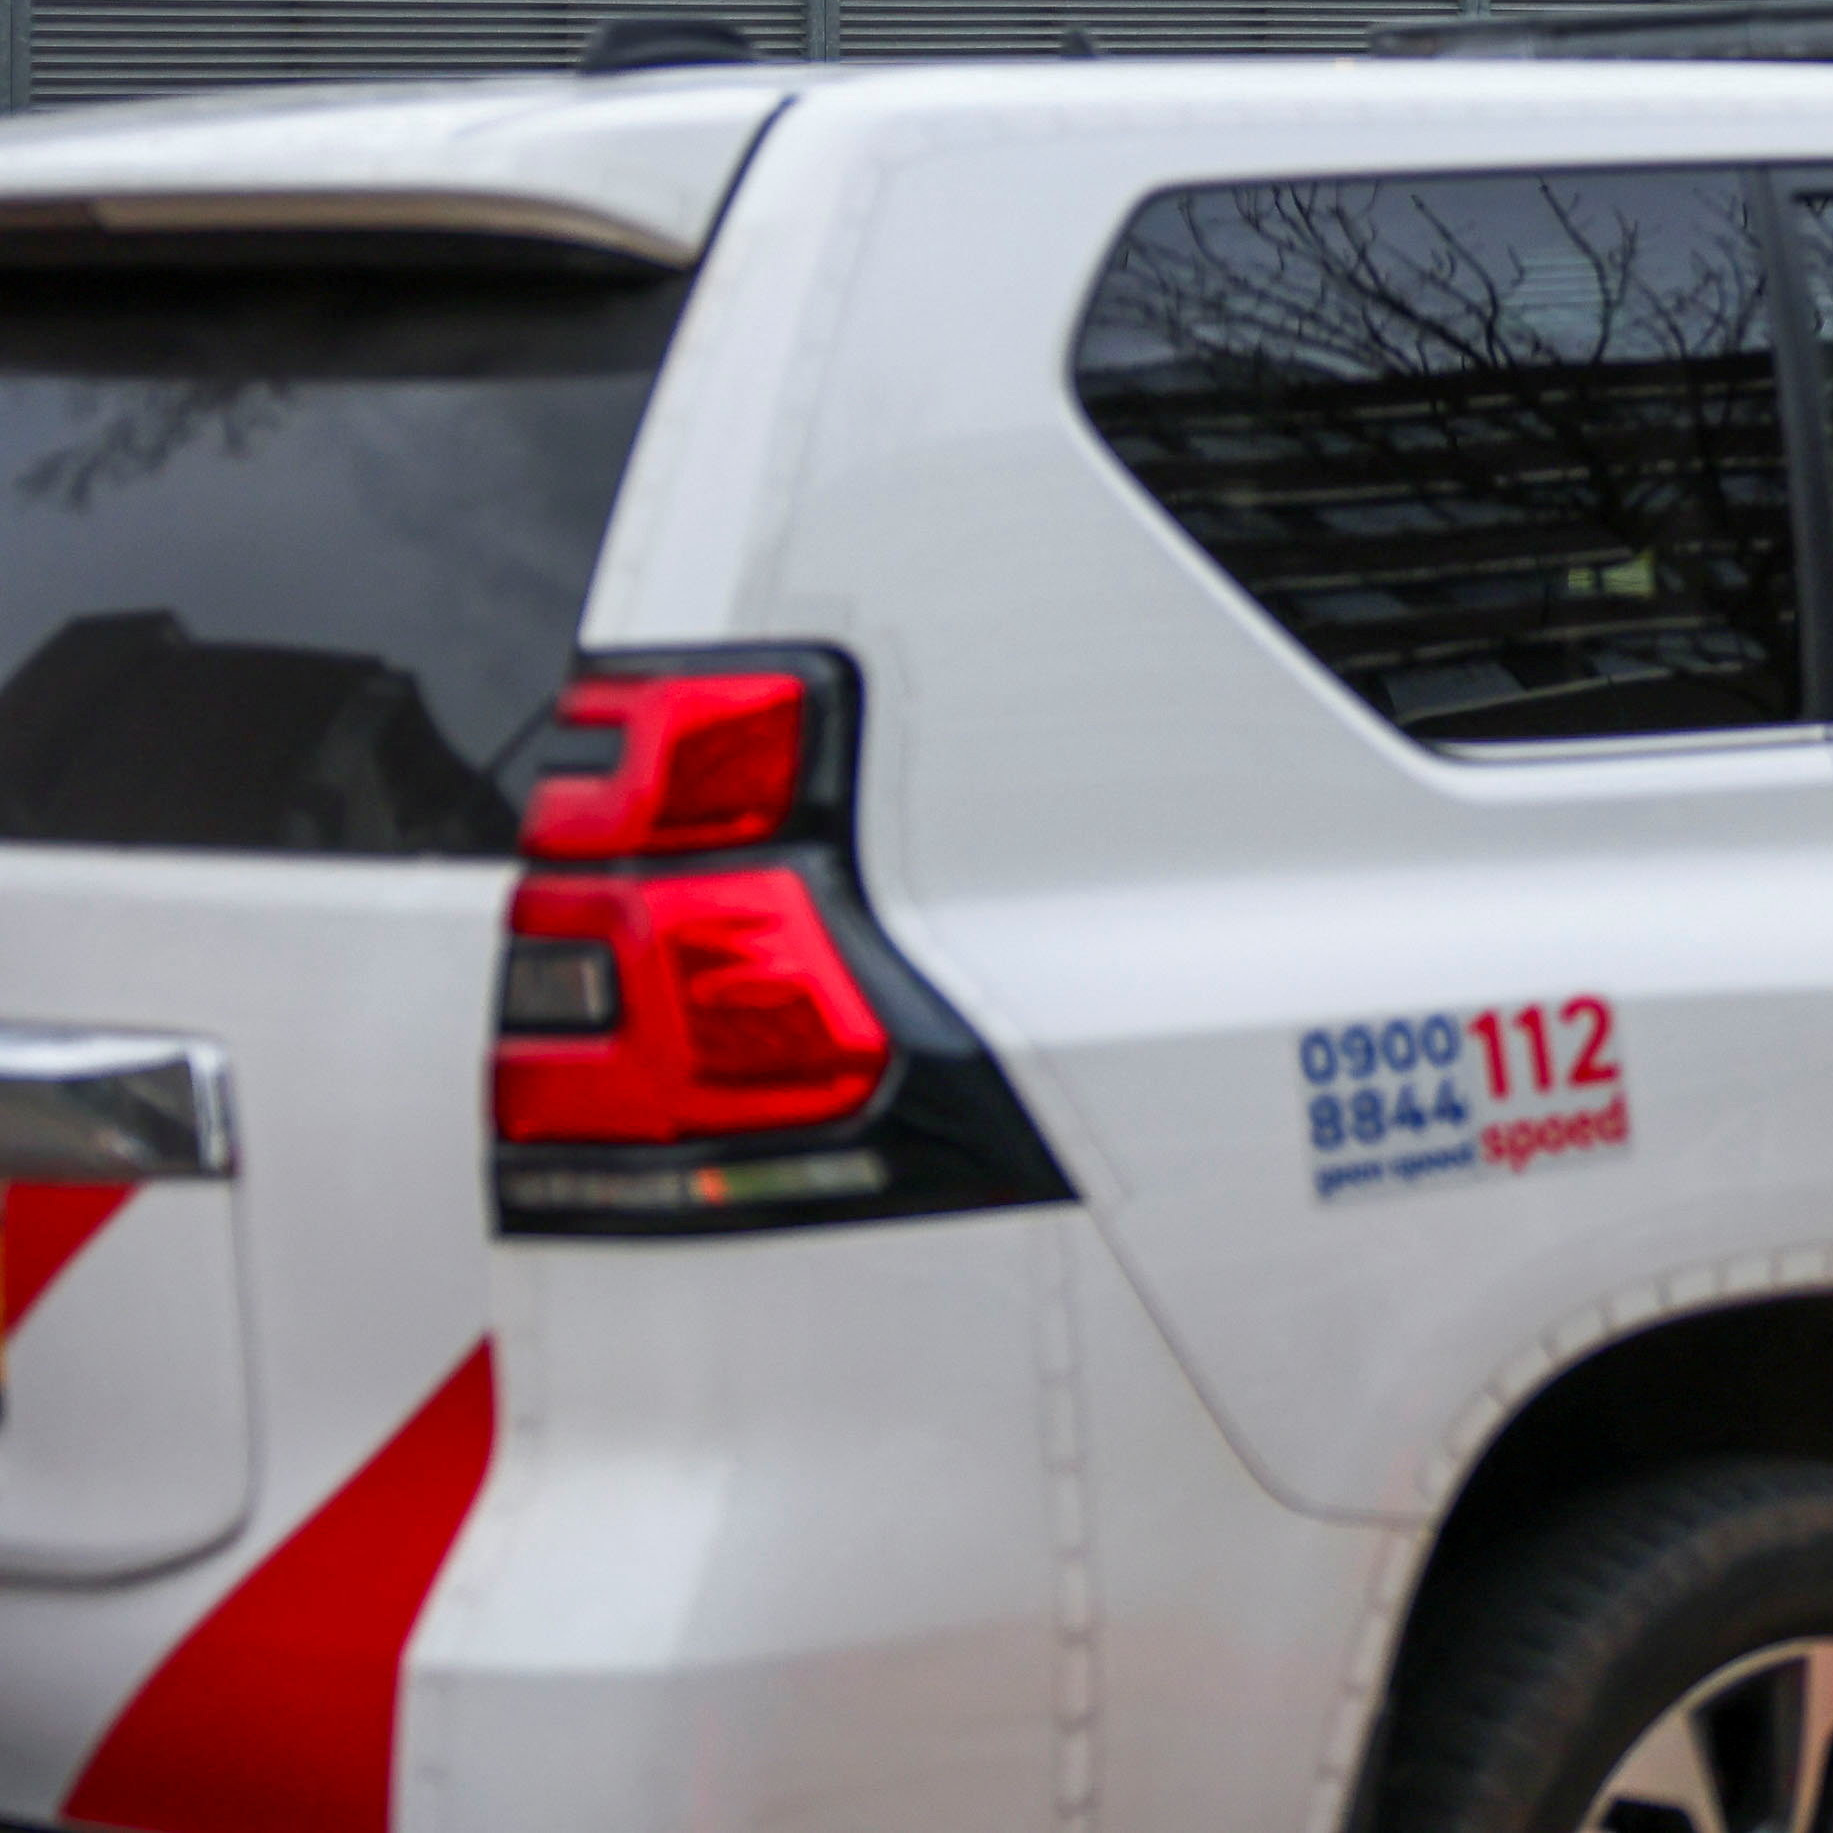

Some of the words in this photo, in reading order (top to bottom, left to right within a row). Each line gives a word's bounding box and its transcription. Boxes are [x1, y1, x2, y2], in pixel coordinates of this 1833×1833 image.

[1299, 1014, 1461, 1088] 0900
[1467, 994, 1622, 1102] 112
[1307, 1076, 1470, 1152] 8844
[1481, 1089, 1630, 1173] spoed
